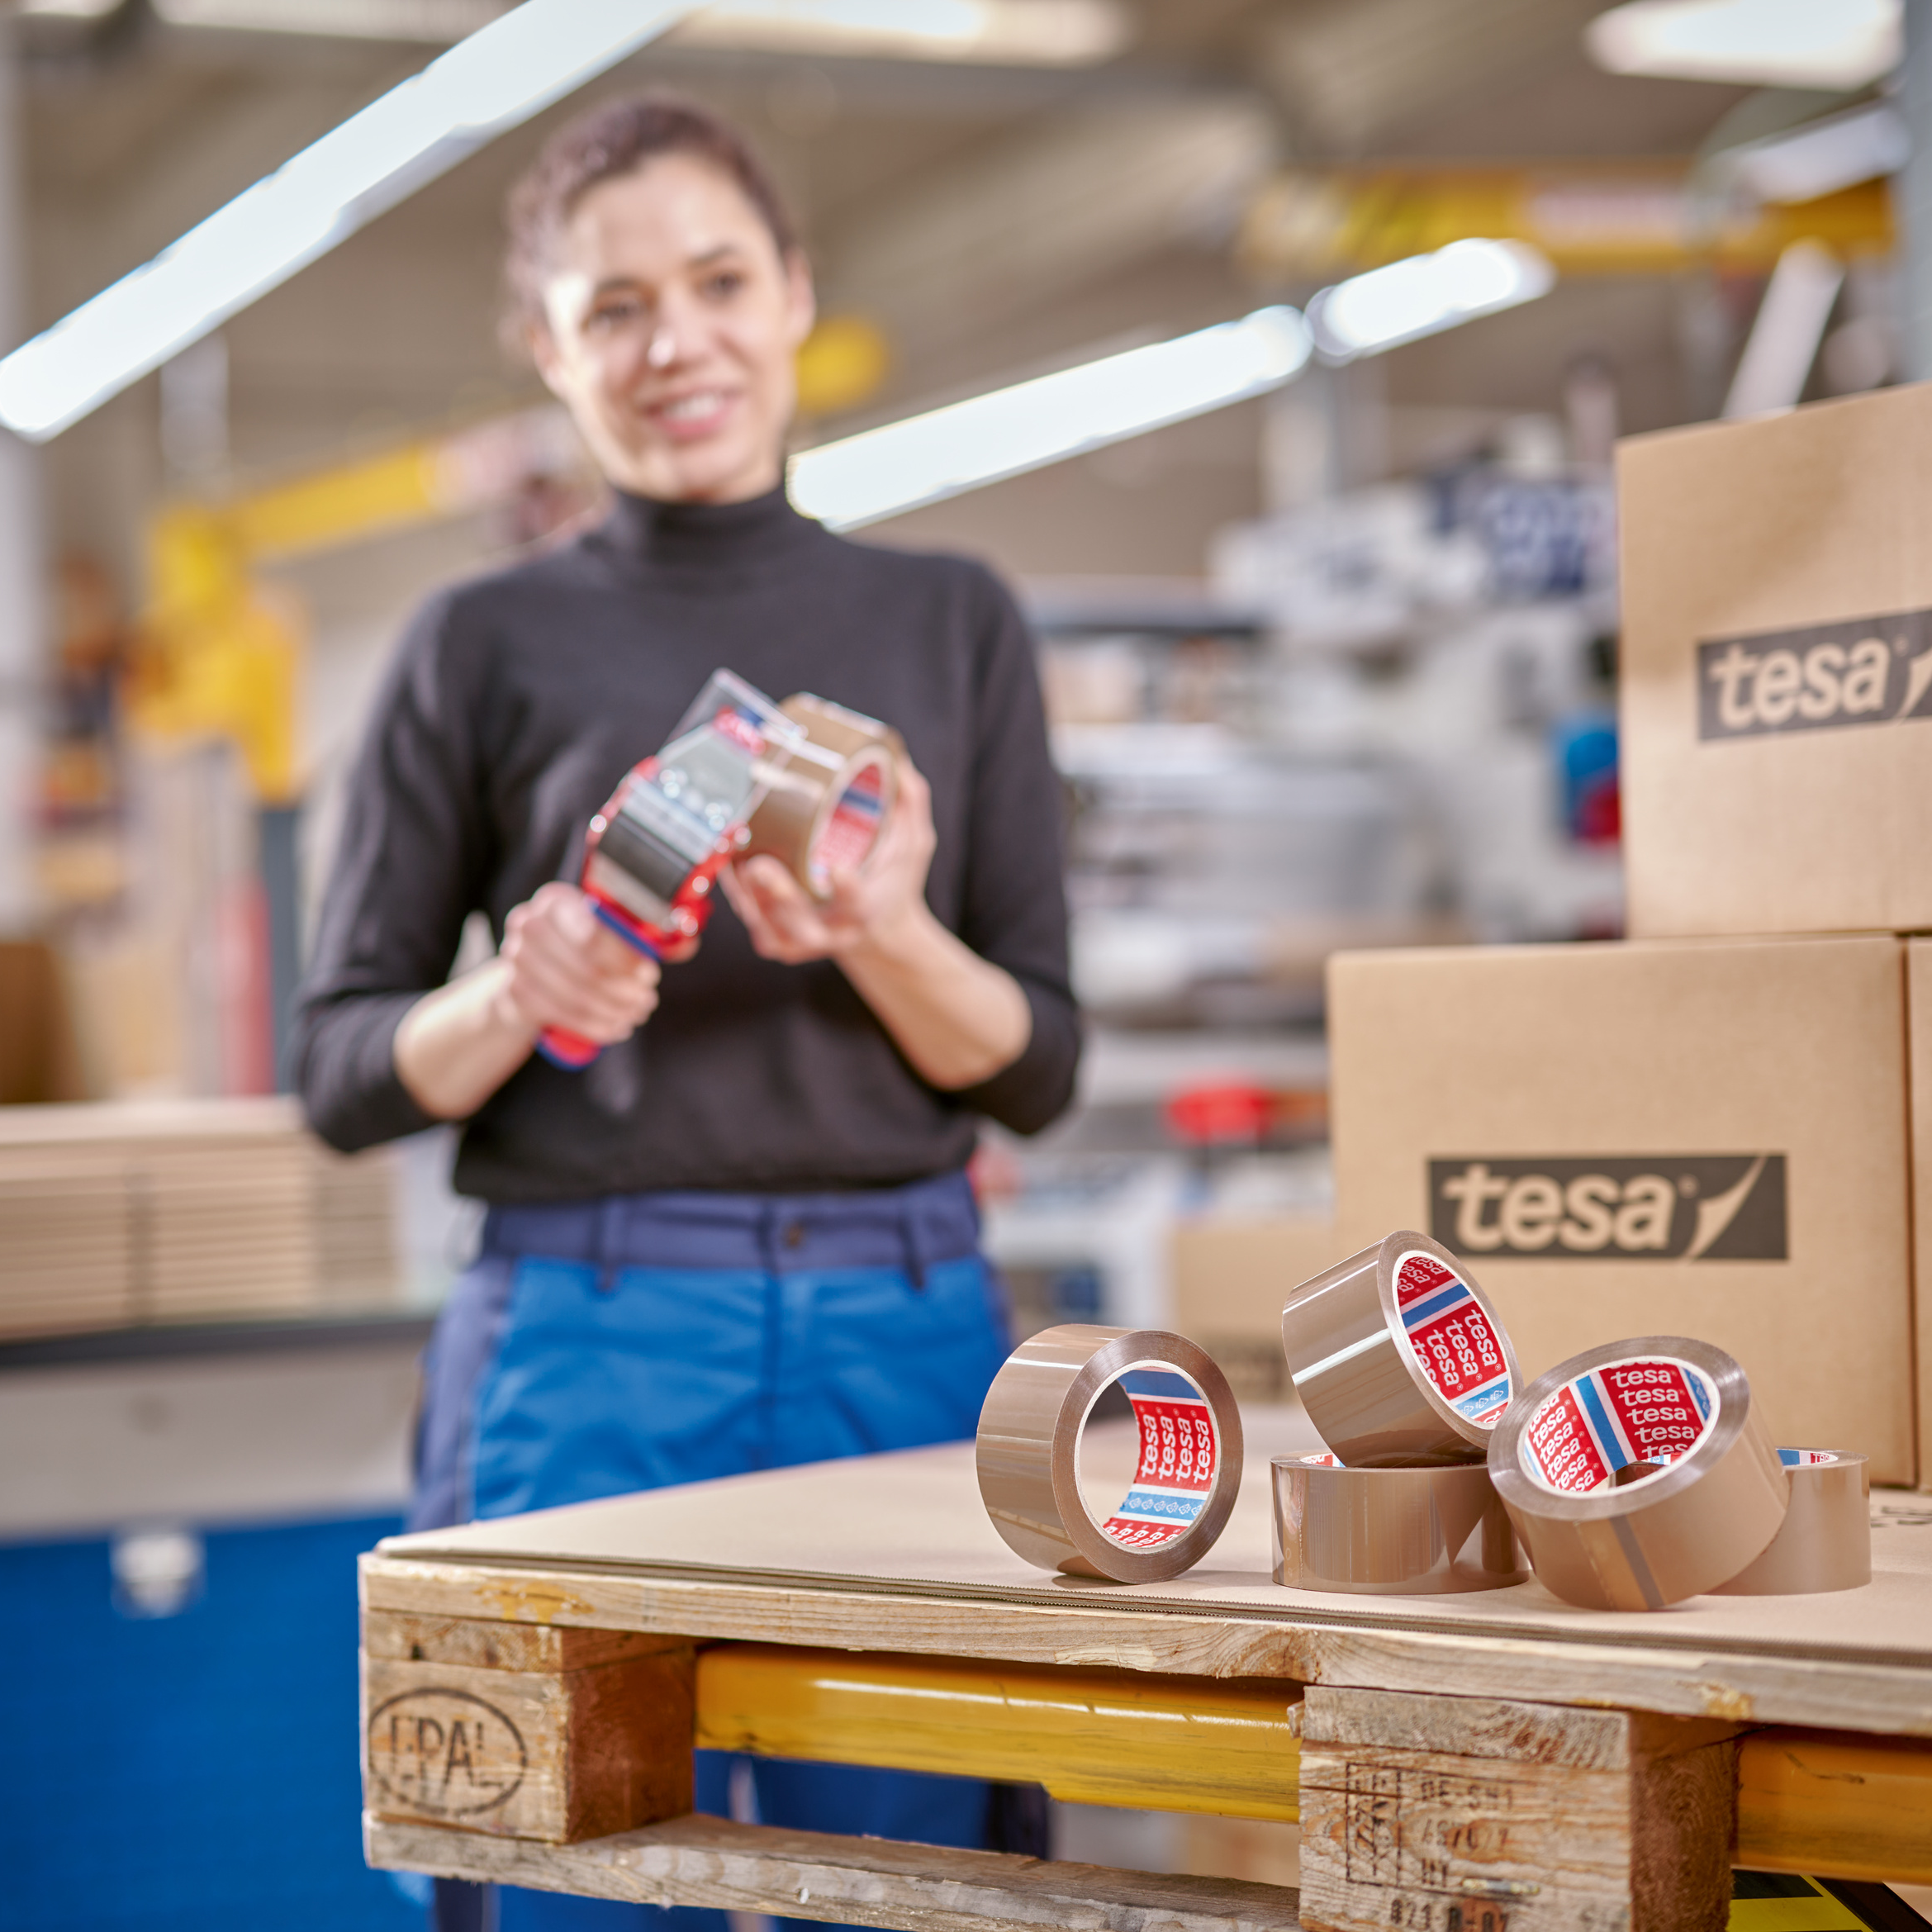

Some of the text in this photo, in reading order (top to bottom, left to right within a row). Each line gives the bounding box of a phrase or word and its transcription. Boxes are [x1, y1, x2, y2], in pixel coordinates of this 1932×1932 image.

[1707, 638, 1891, 730] tesa
[1442, 1163, 1677, 1252] tesa
[1426, 1329, 1460, 1387] tesa
[1445, 1319, 1479, 1377] tesa
[1464, 1309, 1498, 1367] tesa
[1610, 1369, 1673, 1388] tesa
[1618, 1388, 1680, 1407] tesa
[1533, 1406, 1567, 1449] tesa
[1540, 1422, 1574, 1464] tesa
[1626, 1407, 1688, 1426] tesa
[1634, 1425, 1696, 1443] tesa
[1141, 1414, 1159, 1479] tesa
[1158, 1415, 1176, 1480] tesa
[1175, 1417, 1194, 1483] tesa
[1193, 1419, 1211, 1484] tesa
[1547, 1437, 1581, 1481] tesa
